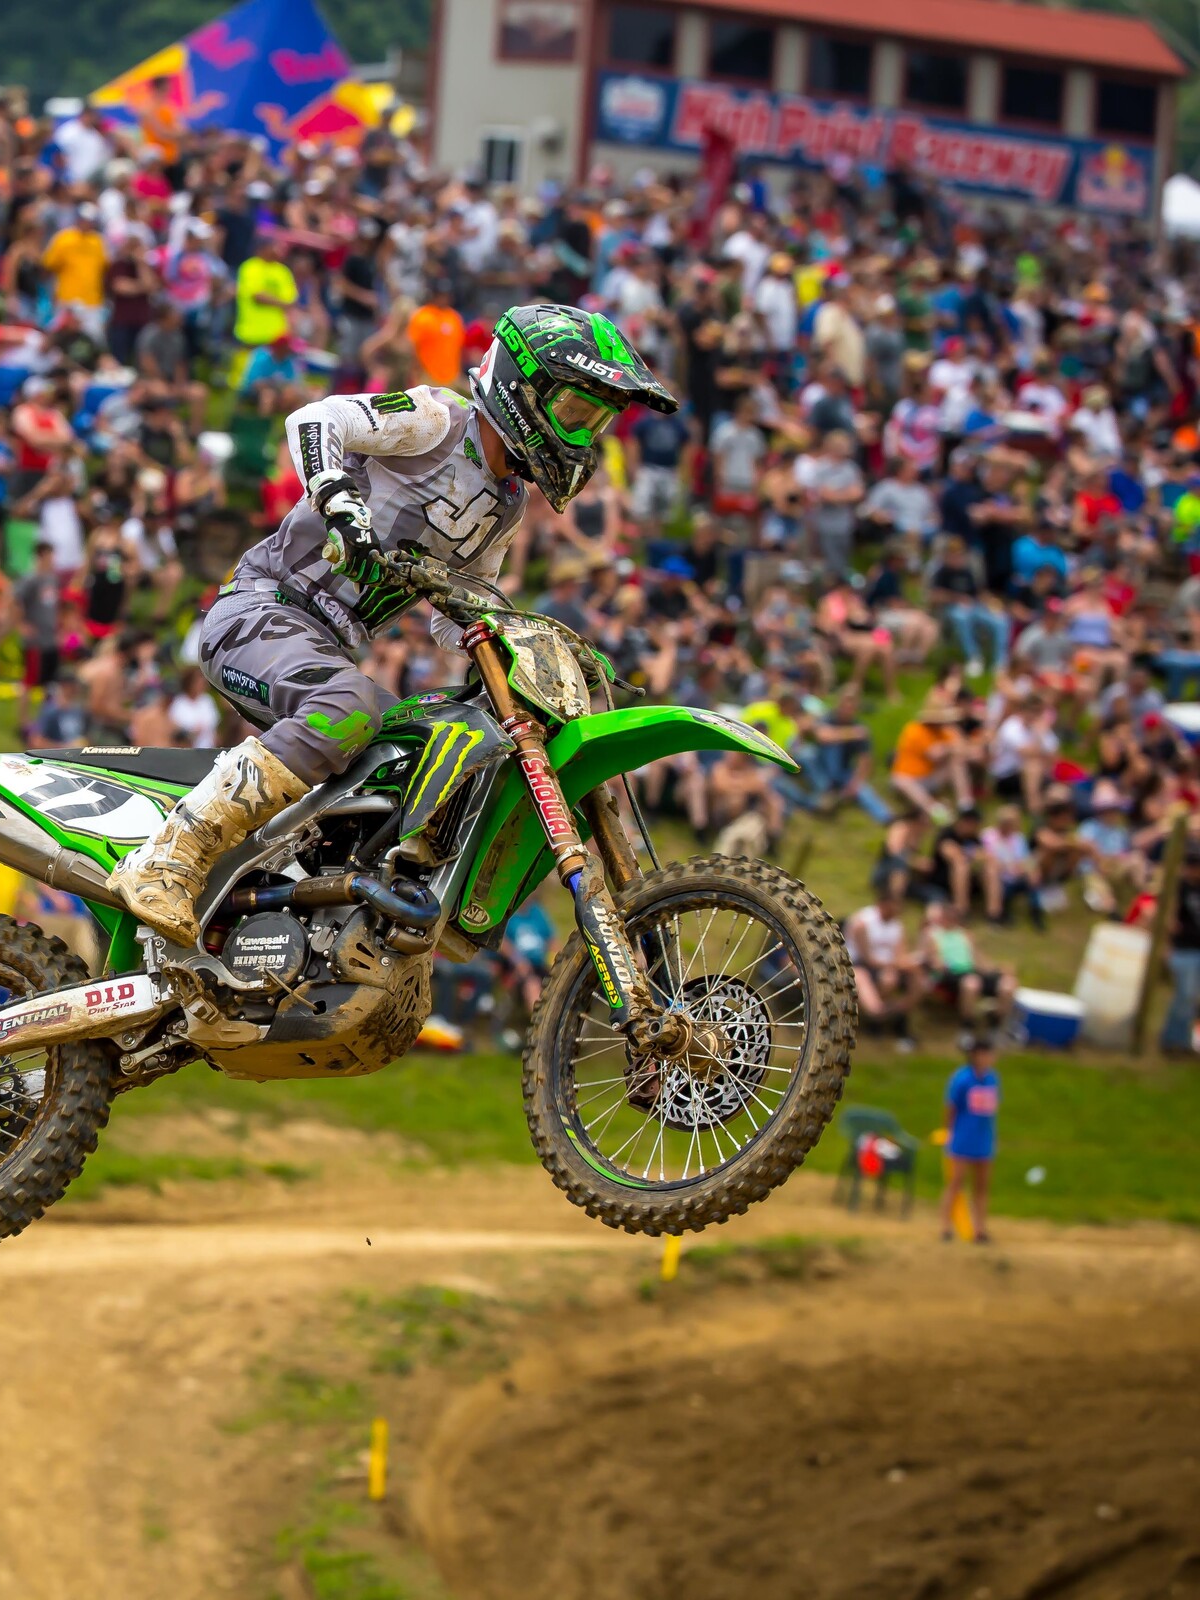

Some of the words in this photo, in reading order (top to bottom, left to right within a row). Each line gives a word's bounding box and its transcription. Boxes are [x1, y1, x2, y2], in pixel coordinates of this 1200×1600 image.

[566, 352, 623, 382] JUST1
[223, 669, 258, 692] MONSTER
[81, 746, 141, 754] Kawasaki
[521, 758, 573, 837] SHOWA
[236, 934, 290, 946] Kawasaki
[233, 954, 287, 965] HINSON
